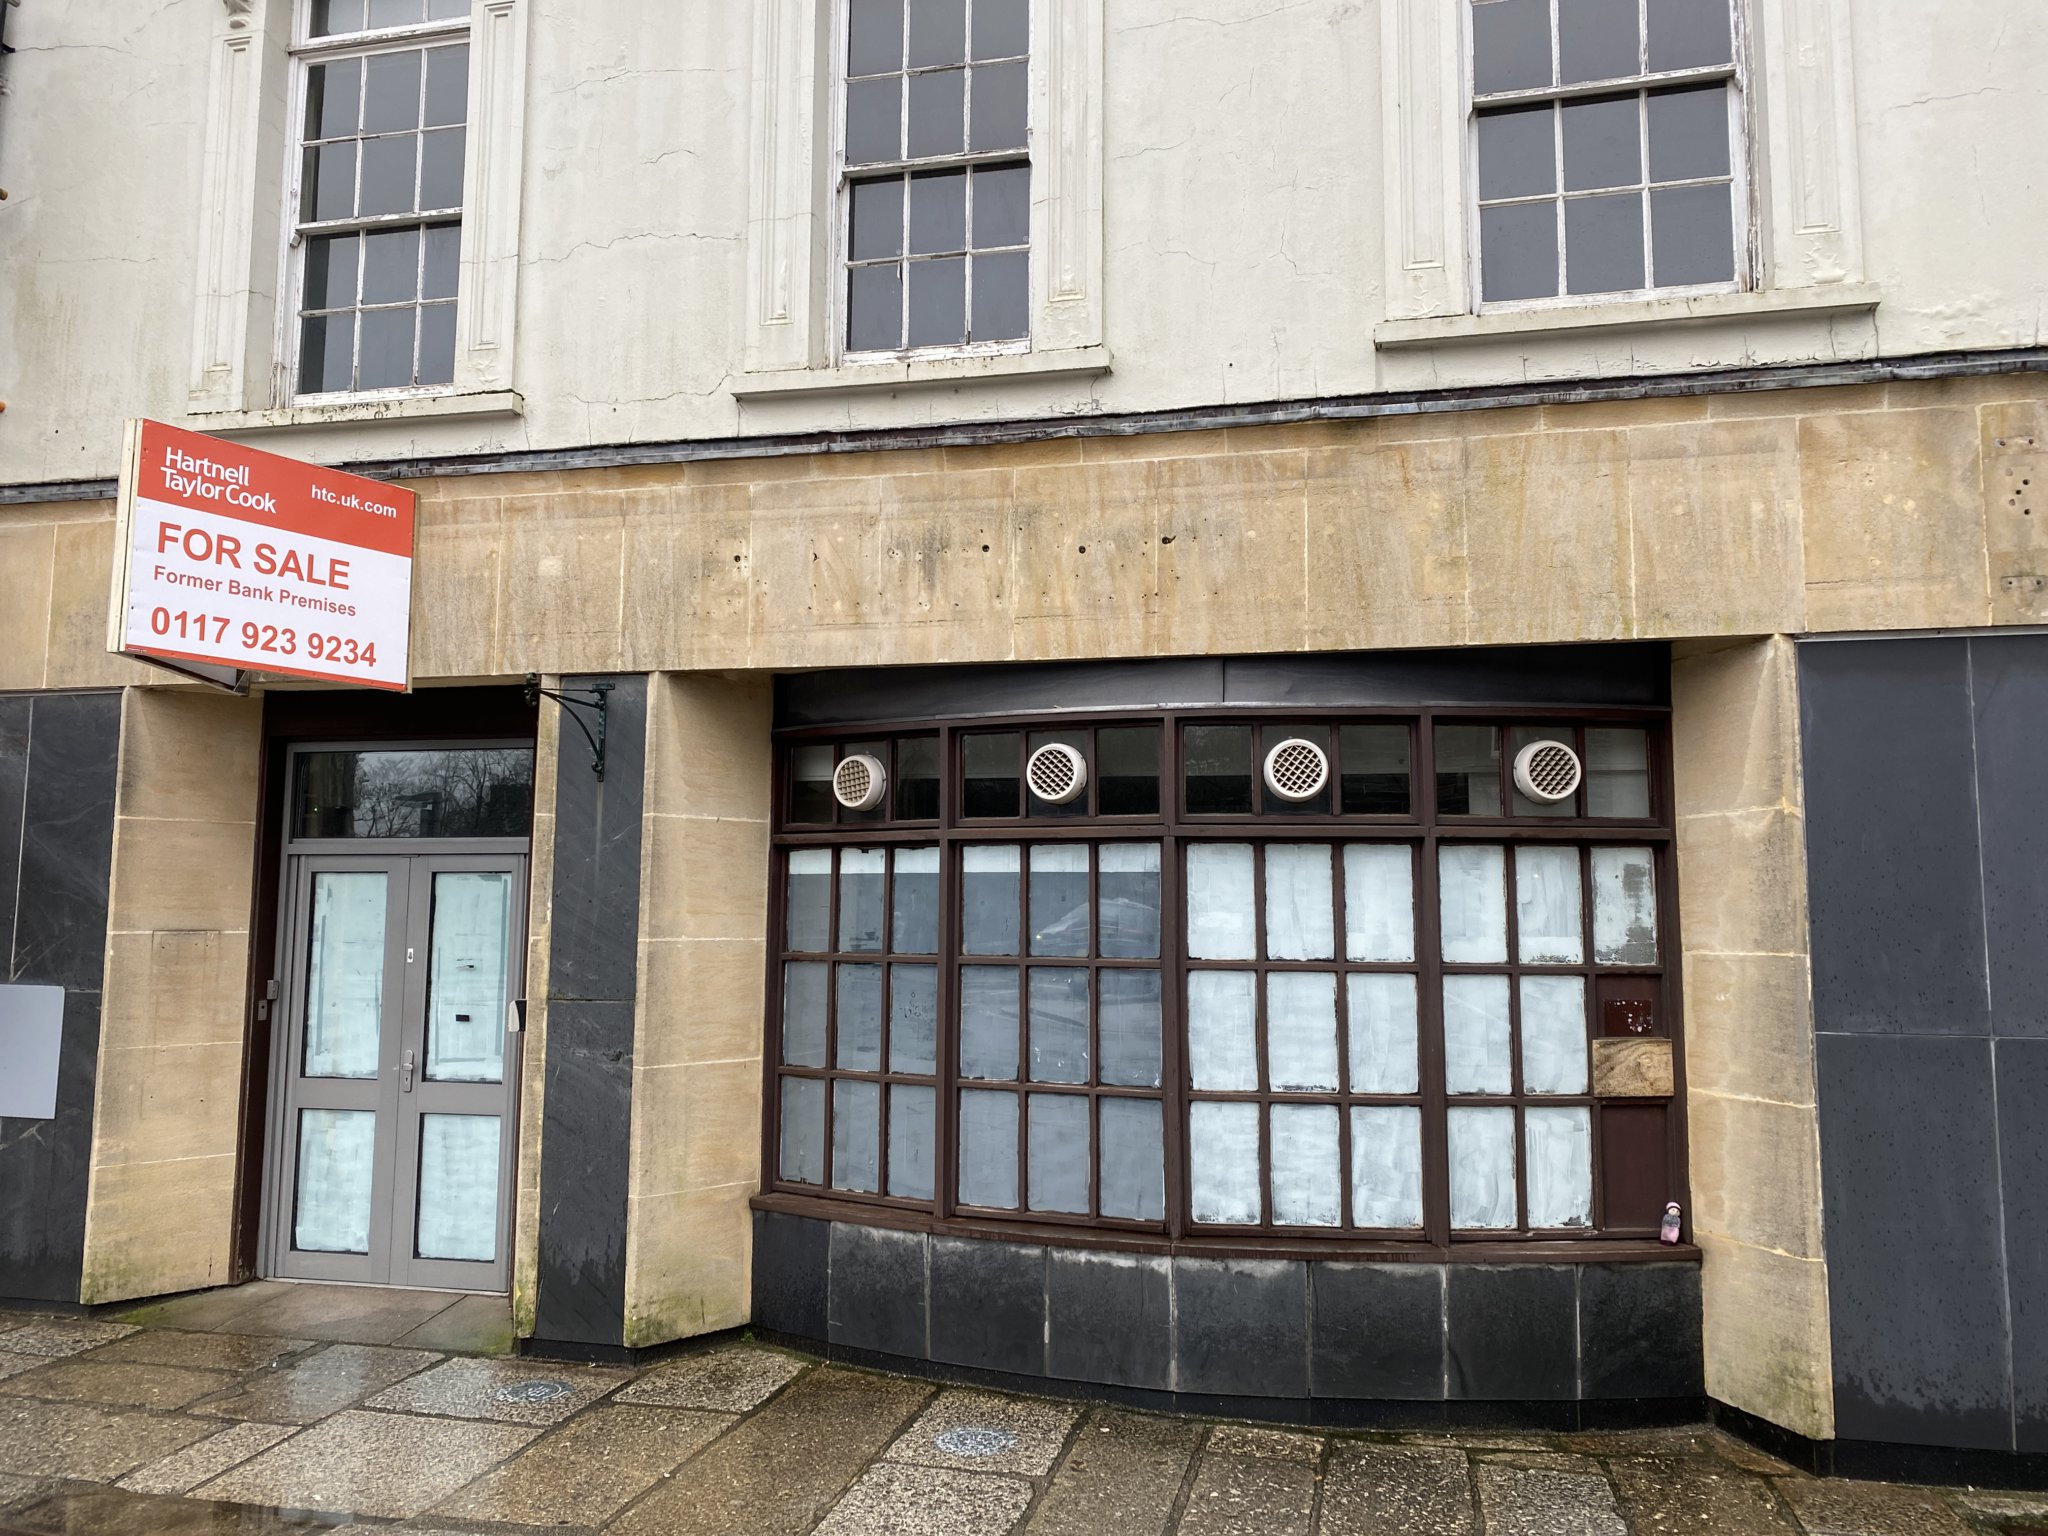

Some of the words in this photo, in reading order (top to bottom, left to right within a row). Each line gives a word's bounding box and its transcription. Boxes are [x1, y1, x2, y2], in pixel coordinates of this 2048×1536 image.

[165, 446, 249, 487] Hartnell
[311, 484, 397, 518] htc.uk.com
[158, 522, 241, 568] FOR
[254, 543, 350, 590] SALE
[154, 565, 222, 592] Former
[229, 580, 273, 601] Bank
[280, 590, 356, 616] Premises
[151, 607, 230, 644] 0117
[242, 622, 296, 654] 923
[308, 633, 376, 667] 9234
